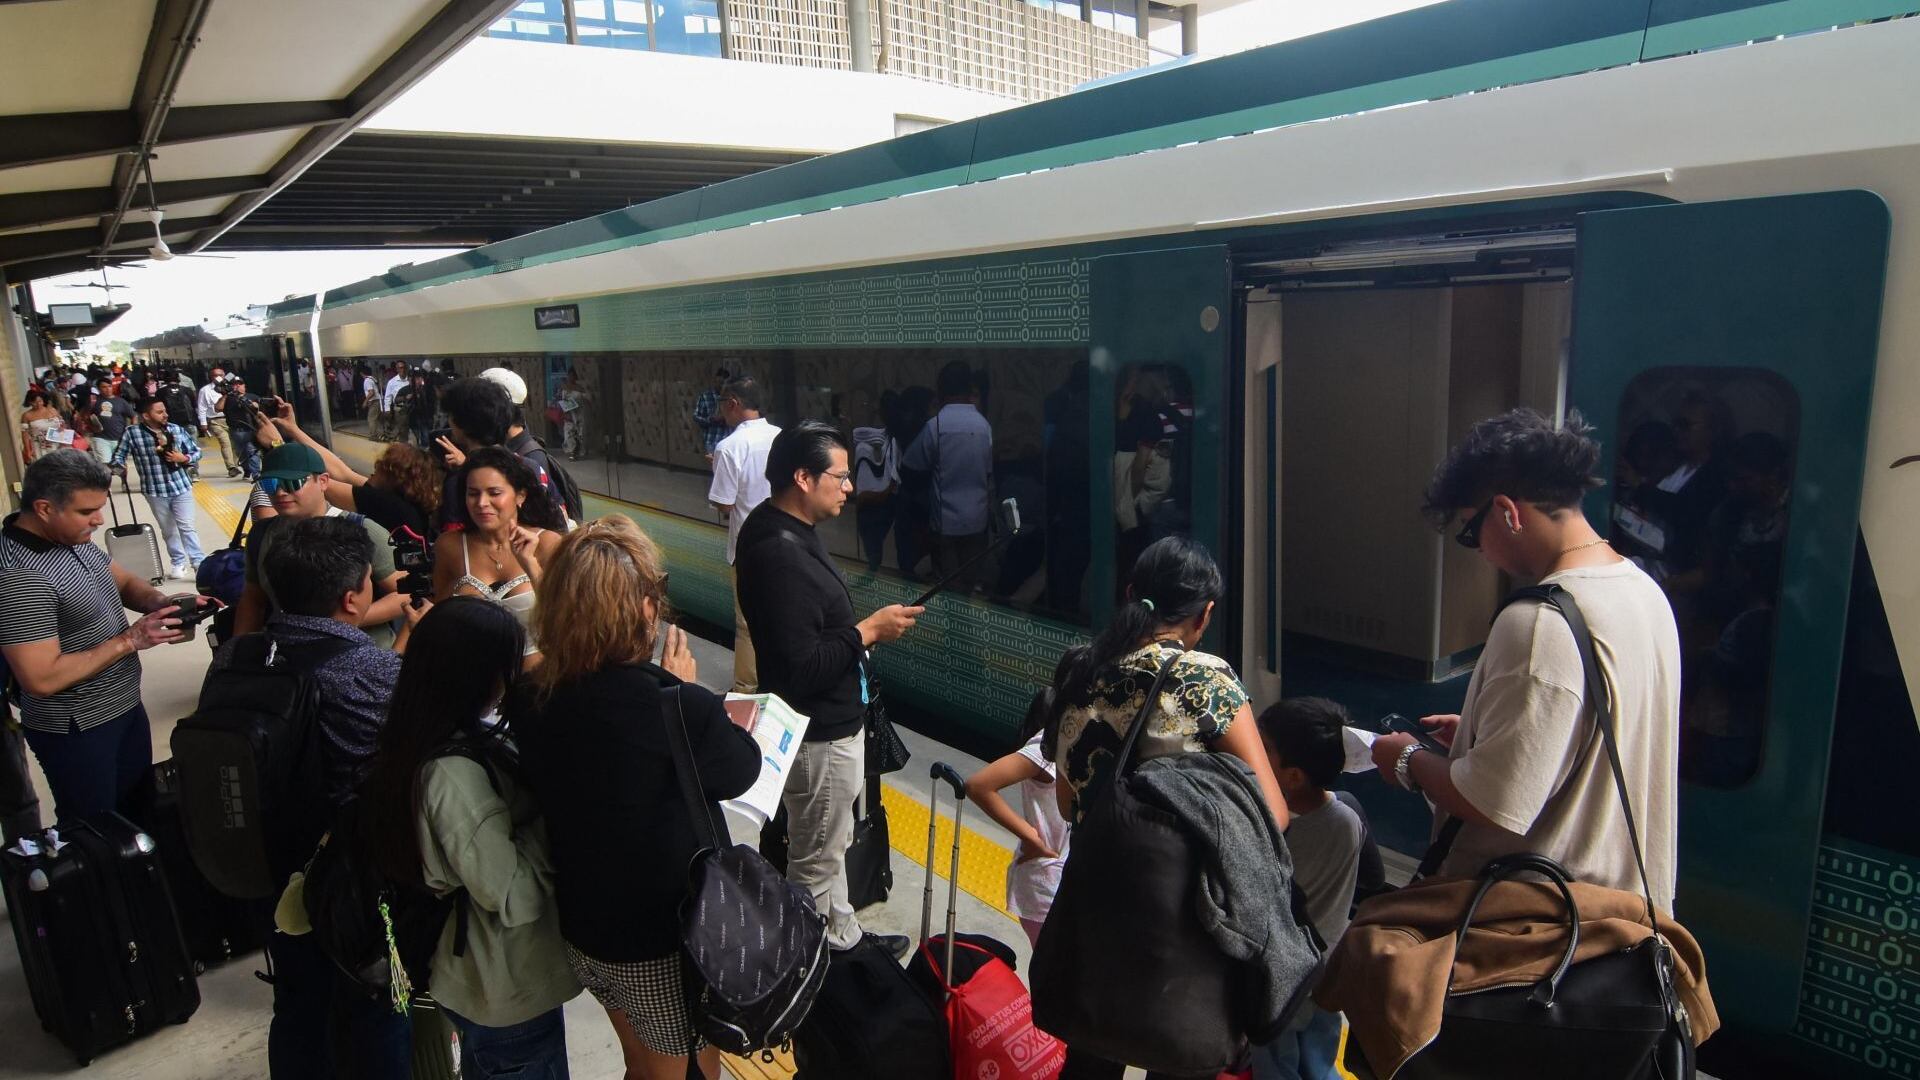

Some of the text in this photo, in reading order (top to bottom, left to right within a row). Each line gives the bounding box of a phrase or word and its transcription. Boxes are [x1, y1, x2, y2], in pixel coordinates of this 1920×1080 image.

[220, 766, 233, 828] GoPro
[967, 1014, 999, 1043] TODAS
[998, 1006, 1013, 1020] TUS
[976, 1017, 1012, 1049] GENERAN
[1011, 1026, 1051, 1062] OXXO
